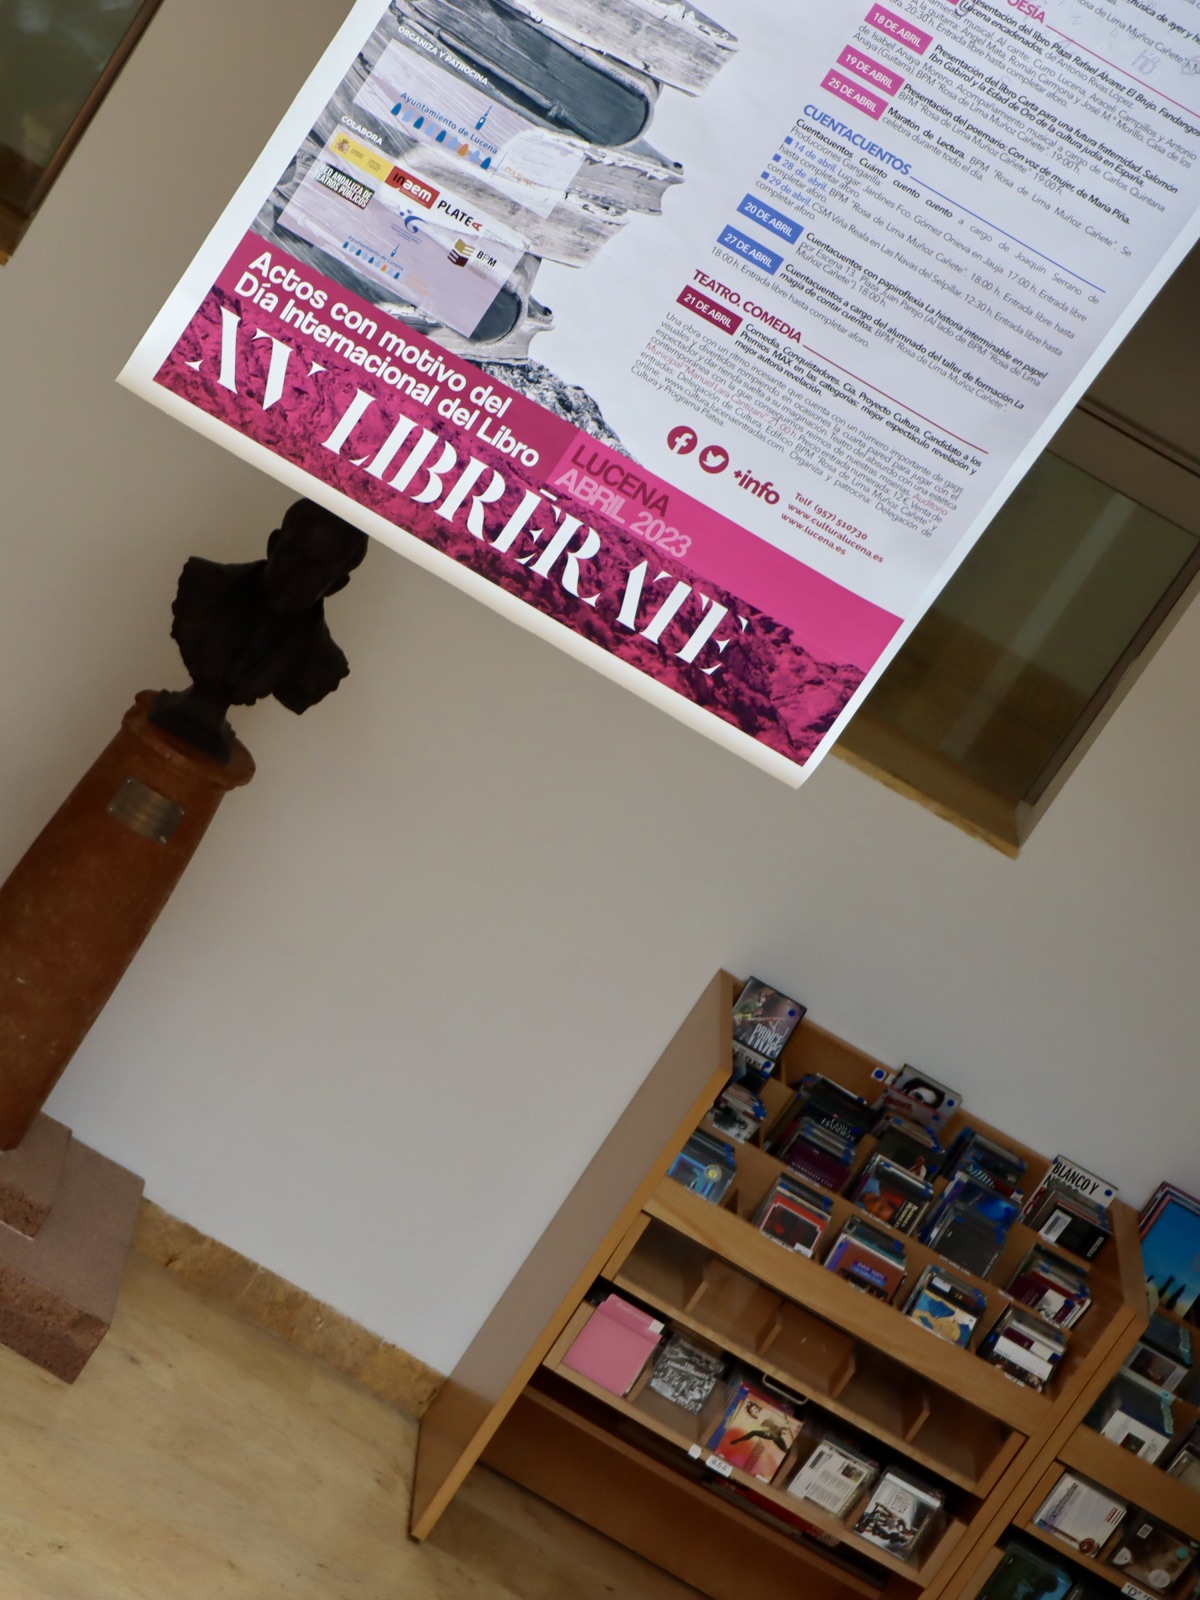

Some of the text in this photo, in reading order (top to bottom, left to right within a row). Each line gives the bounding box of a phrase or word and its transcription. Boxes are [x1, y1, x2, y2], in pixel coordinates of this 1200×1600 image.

[398, 25, 489, 86] ORGANIZA Y PATROCINA
[873, 12, 921, 48] 18 DE ABRIL
[827, 76, 877, 113] 25 DE ABRIL
[845, 53, 893, 89] 19 DE ABRIL
[1017, 23, 1034, 36] del
[1031, 30, 1051, 47] libro
[1050, 42, 1072, 60] Plaza
[1072, 55, 1100, 75] Rafael
[1096, 71, 1126, 92] Álvarez
[1125, 87, 1138, 98] El
[1134, 93, 1157, 111] Brujo.
[341, 115, 383, 145] COLABORA
[396, 92, 498, 155] Ayuntamiento de Lucena
[803, 104, 911, 175] CUENTACUENTOS
[887, 106, 965, 160] Maratón de Lectura.
[934, 43, 1178, 194] Presentación del libro Carta para una futura fraternidad. Salomón
[795, 118, 953, 218] Cuentacuentos Cuánto cuento cuento
[903, 83, 1130, 225] Presentación del poemario: Con voz de mujer, de María Piña.
[330, 171, 364, 195] ANDALUZA
[361, 189, 373, 200] DE
[337, 184, 369, 208] PÚBLICOS
[436, 199, 483, 232] PLATEA
[743, 201, 792, 237] 20 DE ABRIL
[475, 250, 497, 267] BPM
[723, 232, 772, 268] 27 DE ABRIL
[683, 292, 731, 328] 21 DE ABRIL
[693, 269, 801, 343] TEATRO. COMEDIA
[778, 272, 873, 333] magia de contar cuentos.
[806, 232, 1049, 379] Cuentacuentos con papiroflexia La historia interminable en papel
[186, 306, 326, 411] XV
[249, 252, 512, 418] Actos con motivo del
[785, 263, 1025, 410] Cuentacuentos a cargo del alumnado del taller de formación La
[234, 271, 539, 467] Día Internacional del Libro
[745, 323, 780, 350] Comedia.
[780, 346, 840, 386] Conquistadores.
[842, 382, 856, 396] Cía.
[858, 391, 892, 416] Proyecto
[892, 412, 920, 434] Cultura.
[922, 430, 962, 457] Candidato
[969, 455, 981, 467] los
[571, 445, 669, 516] LUCENA
[555, 469, 692, 558] ABRIL 2023
[781, 513, 846, 555] www.lucena.es
[787, 504, 883, 563] www.culturalucena.es
[794, 491, 868, 540] Telf. (957) 510730
[751, 1022, 784, 1048] PRINCE
[1051, 1160, 1100, 1197] BLANCO Y
